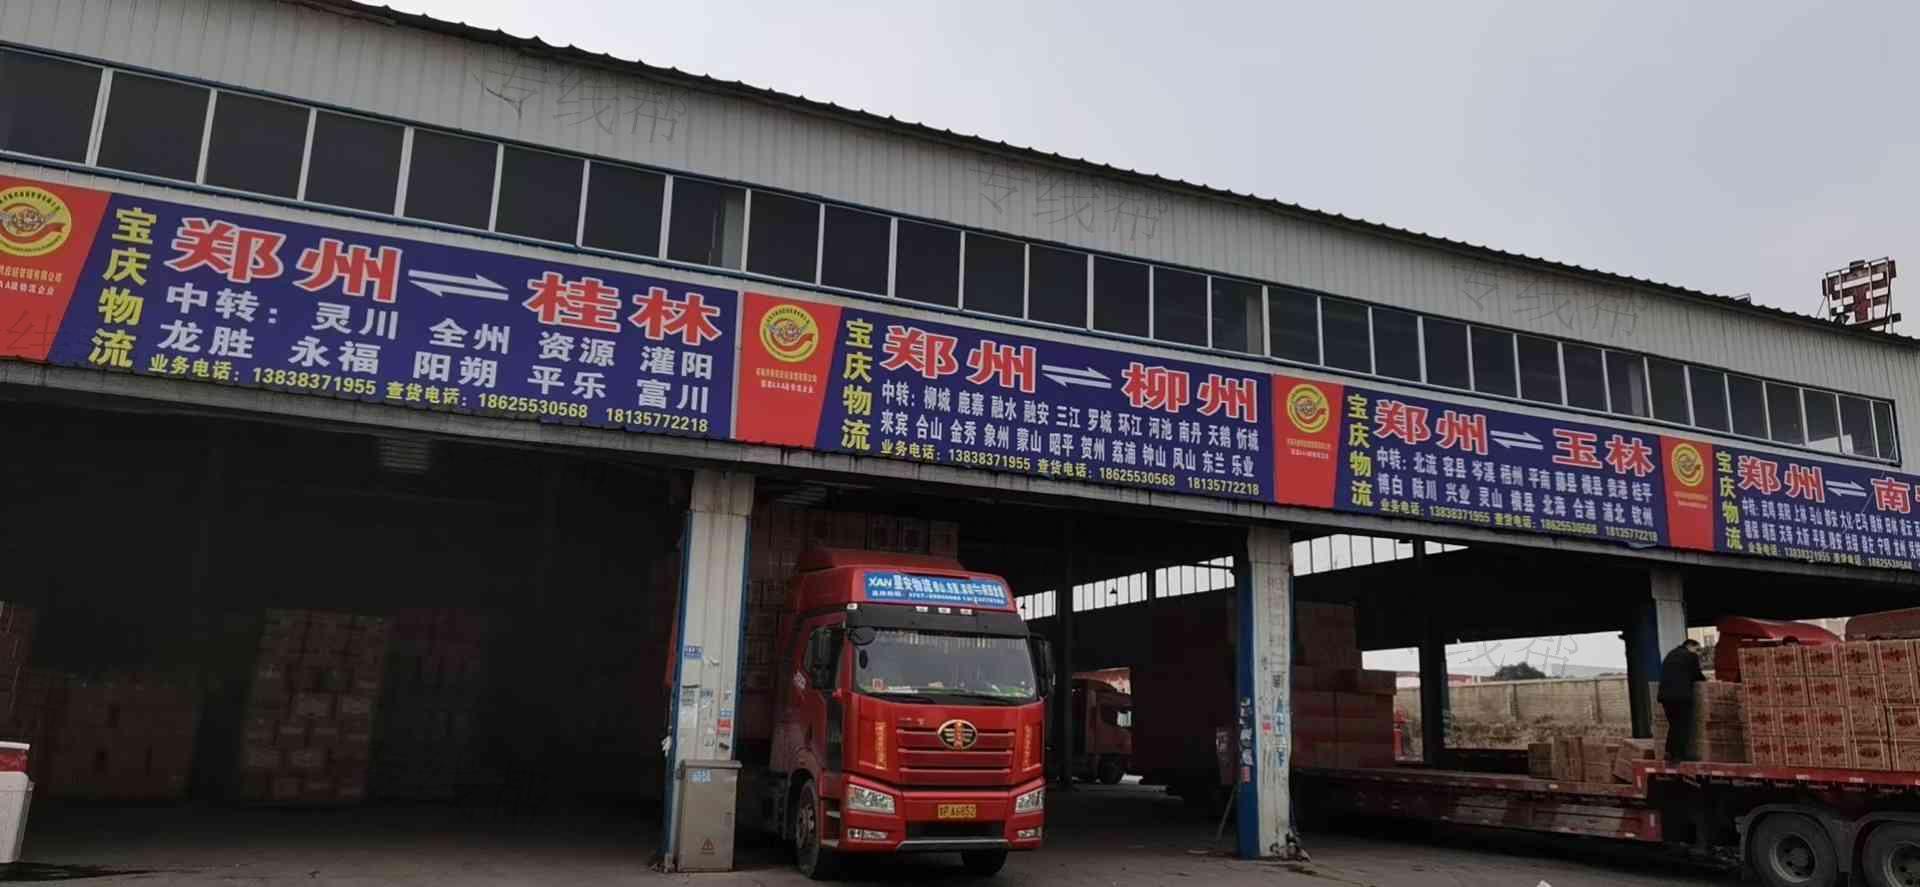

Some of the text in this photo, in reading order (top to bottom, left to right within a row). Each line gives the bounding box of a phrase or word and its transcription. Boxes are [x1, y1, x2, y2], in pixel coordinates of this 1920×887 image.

[88, 207, 157, 369] 宝庆物流
[164, 217, 723, 347] 郑州 桂林
[157, 319, 709, 414] 龙胜 永福 阳朔 平乐 富川
[312, 302, 399, 340] 灵川
[429, 317, 511, 355] 全州
[538, 331, 616, 368] 资源
[639, 345, 713, 381] 灌阳
[880, 324, 1258, 424] 郑州 柳州
[605, 407, 708, 433] 18135772218
[841, 318, 874, 451] 宝庆物流
[924, 384, 951, 413] 柳城
[957, 389, 984, 417] 鹿寨
[991, 395, 1017, 421] 融水
[1023, 399, 1049, 426] 融安
[1056, 404, 1080, 429] 三江
[1087, 408, 1112, 434] 罗城
[1117, 412, 1143, 437] 环江
[1148, 416, 1173, 441] 河池
[1178, 420, 1202, 445] 南丹
[1236, 427, 1259, 452] 忻城
[880, 408, 909, 437] 来宾
[915, 413, 943, 441] 合山
[950, 418, 977, 446] 金秀
[984, 422, 1009, 450] 象州
[1016, 427, 1042, 453] 蒙山
[1049, 432, 1075, 458] 昭平
[1080, 436, 1105, 461] 贺州
[1111, 439, 1136, 466] 荔浦
[1142, 443, 1166, 468] 钟山
[1202, 450, 1226, 475] 东兰
[1231, 454, 1255, 478] 乐业
[1347, 393, 1374, 508] 宝庆物流
[1373, 399, 1656, 478] 郑州 玉林
[1413, 451, 1438, 476] 北流
[1187, 476, 1260, 496] 18135772218
[1411, 477, 1437, 501] 陆川
[1445, 482, 1471, 505] 兴业
[1479, 486, 1504, 509] 灵山
[1715, 451, 1743, 550] 宝庆物流
[1737, 454, 1825, 504] 郑州
